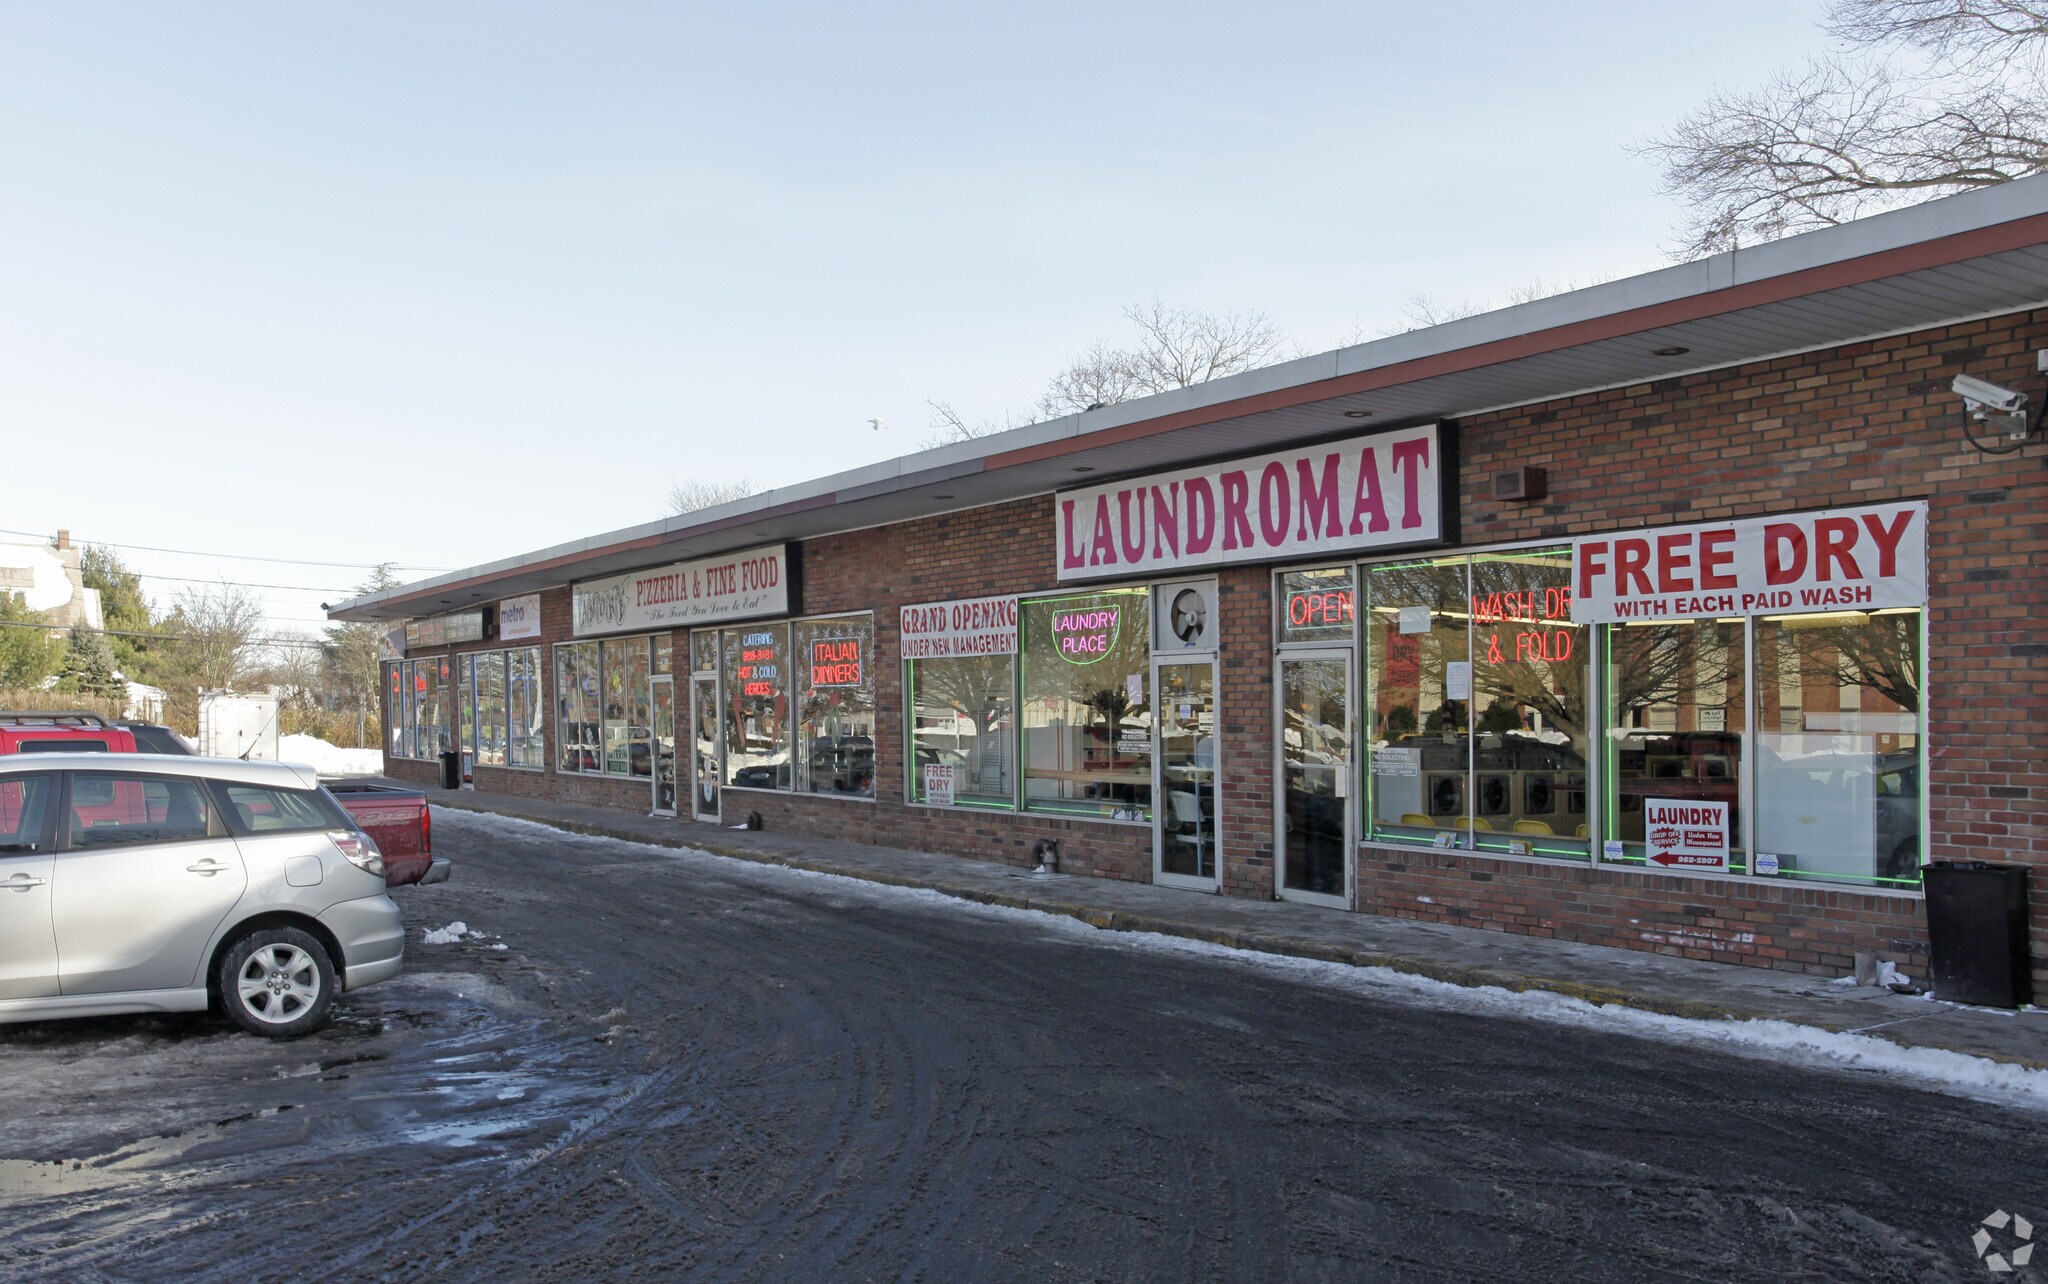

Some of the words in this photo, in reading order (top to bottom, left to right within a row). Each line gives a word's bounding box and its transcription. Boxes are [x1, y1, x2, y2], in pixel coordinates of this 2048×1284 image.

[1062, 437, 1429, 569] LAUNDROMAT
[1579, 529, 1738, 599] FREE
[1764, 510, 1916, 586] DRY
[636, 572, 688, 607] PIZZERIA
[692, 571, 700, 600] &
[706, 563, 736, 598] FINE
[741, 556, 778, 592] FOOD
[668, 605, 687, 618] Food
[691, 604, 707, 616] You
[709, 601, 728, 614] Love
[732, 601, 740, 611] to
[1290, 591, 1353, 625] OPEN
[1545, 586, 1572, 618] DR
[1614, 599, 1668, 617] WITH
[1675, 596, 1734, 614] EACH
[1742, 591, 1793, 610] PAID
[1800, 585, 1872, 606] WASH
[902, 606, 947, 634] GRAND
[952, 598, 1017, 631] OPENING
[1054, 611, 1118, 632] LAUNDRY
[743, 632, 773, 646] CATERING
[902, 639, 929, 657] UNDER
[932, 637, 950, 656] NEW
[953, 632, 1017, 654] MANAGEMENT
[1062, 634, 1107, 653] PLACE
[1488, 634, 1506, 664] &
[1516, 630, 1570, 662] FOLD
[814, 641, 858, 662] ITALIAN
[738, 666, 752, 679] HOT
[752, 666, 758, 679] &
[758, 665, 776, 678] COLD
[812, 663, 860, 684] DINNERS
[744, 682, 770, 695] HEROES
[926, 765, 952, 777] FREE
[929, 779, 949, 790] DRY
[1648, 807, 1722, 826] LAUNDRY
[1653, 838, 1679, 846] SERVICE
[1668, 830, 1680, 838] OFF
[1686, 838, 1722, 846] Management
[1678, 856, 1718, 864] 968-5907
